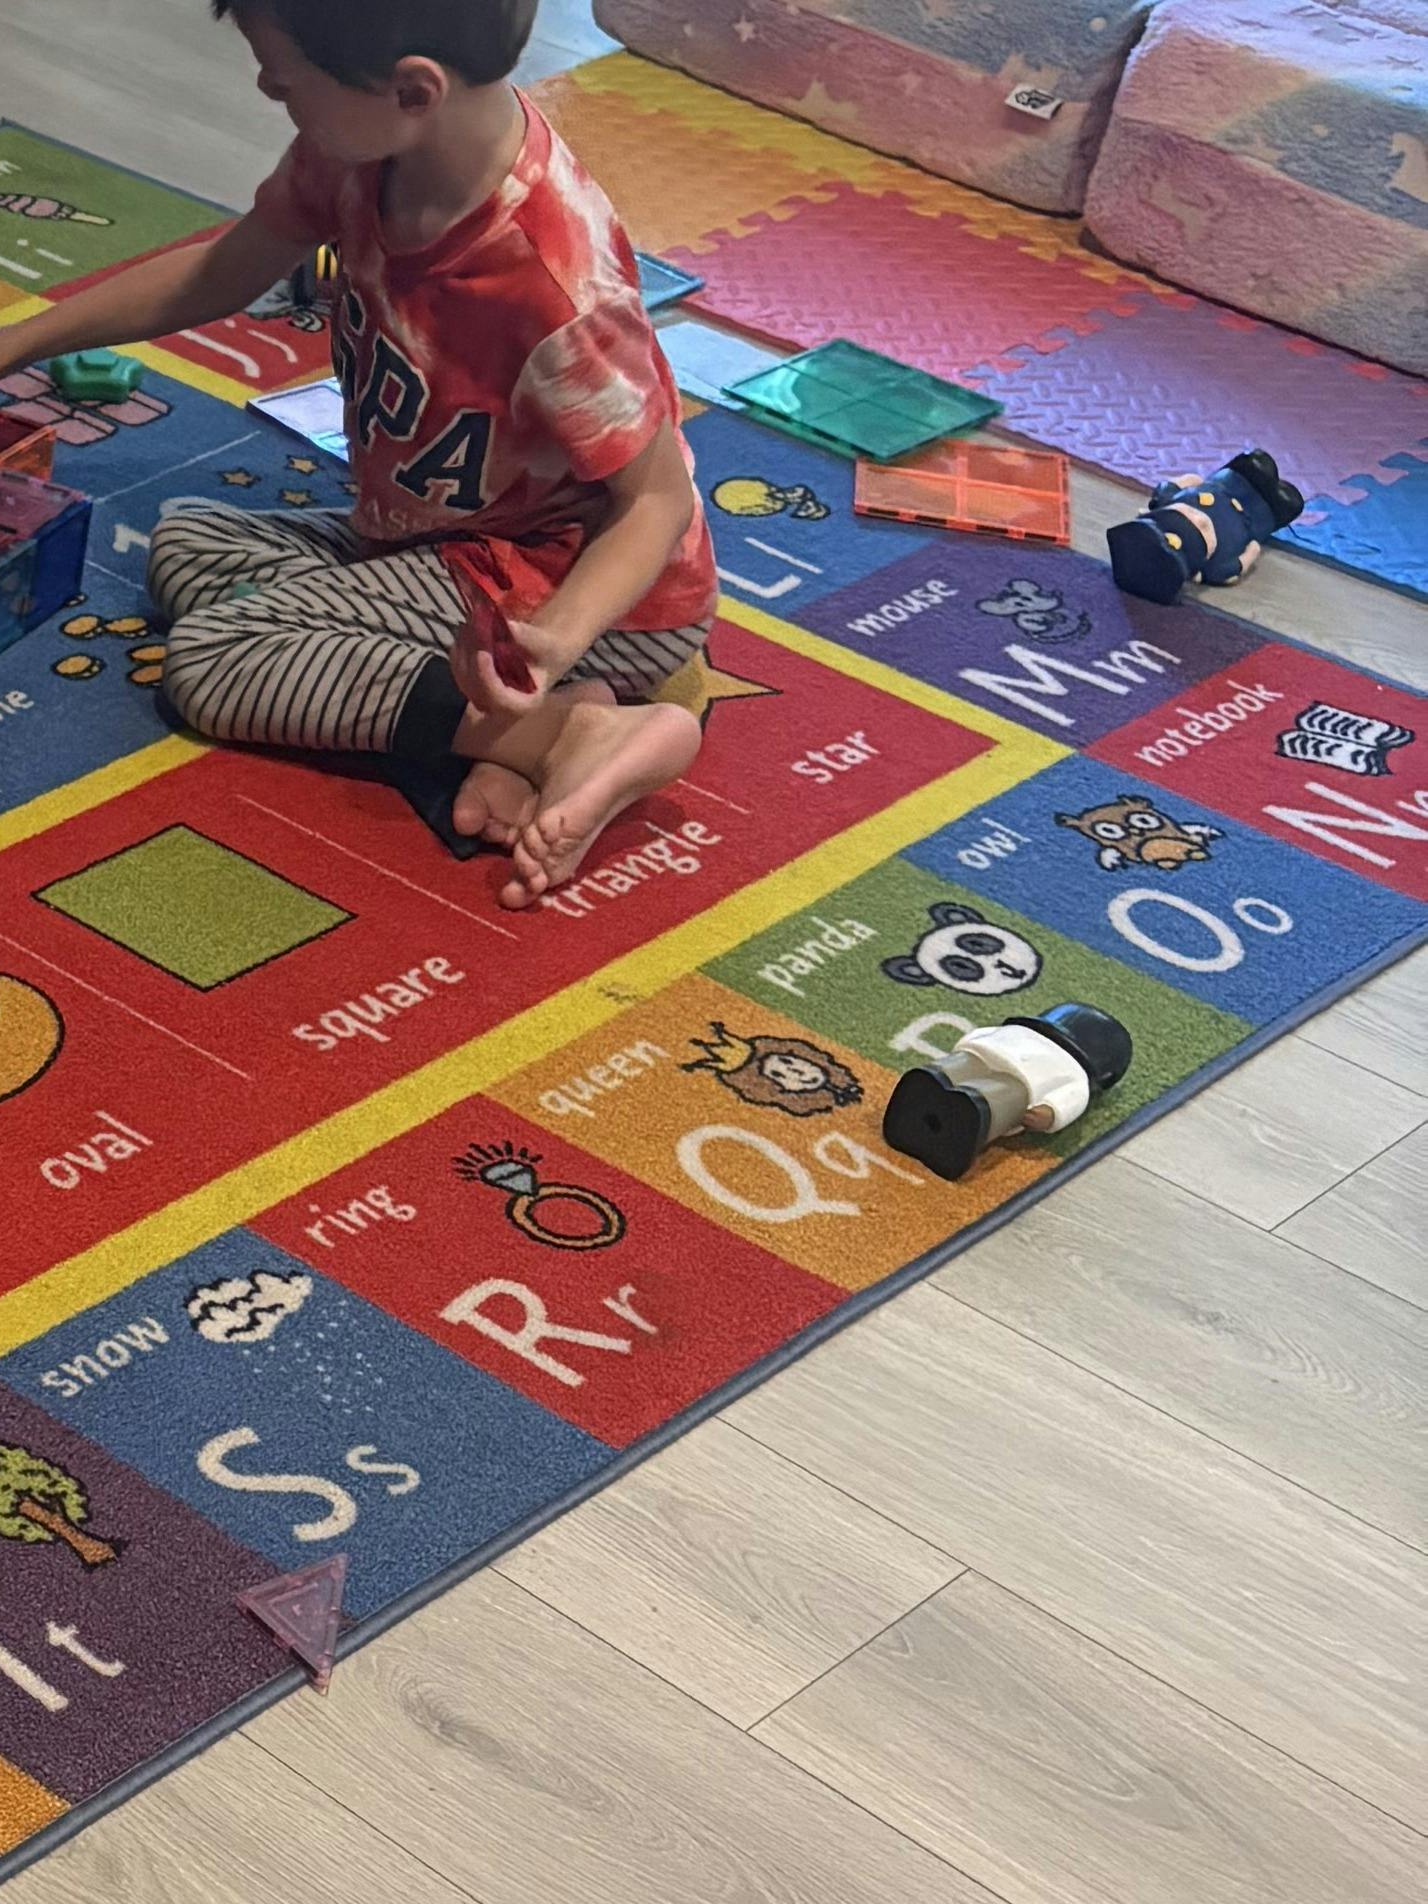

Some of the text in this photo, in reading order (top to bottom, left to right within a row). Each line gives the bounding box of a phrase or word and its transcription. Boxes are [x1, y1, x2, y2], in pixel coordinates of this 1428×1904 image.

[847, 576, 959, 636] mouse
[959, 636, 1182, 728] Mm
[1135, 678, 1285, 770] notebook
[790, 727, 882, 786] star
[541, 818, 723, 919] triangle
[956, 817, 1033, 873] owl
[755, 912, 878, 1008] panda
[1107, 886, 1294, 974] Oo
[292, 948, 465, 1054] square
[537, 1036, 672, 1120] queen
[38, 1109, 153, 1192] oval
[675, 1122, 928, 1226] Qq
[303, 1182, 416, 1252] ring
[41, 1315, 171, 1399] snow
[438, 1278, 659, 1390] Rr
[194, 1424, 425, 1546] Ss
